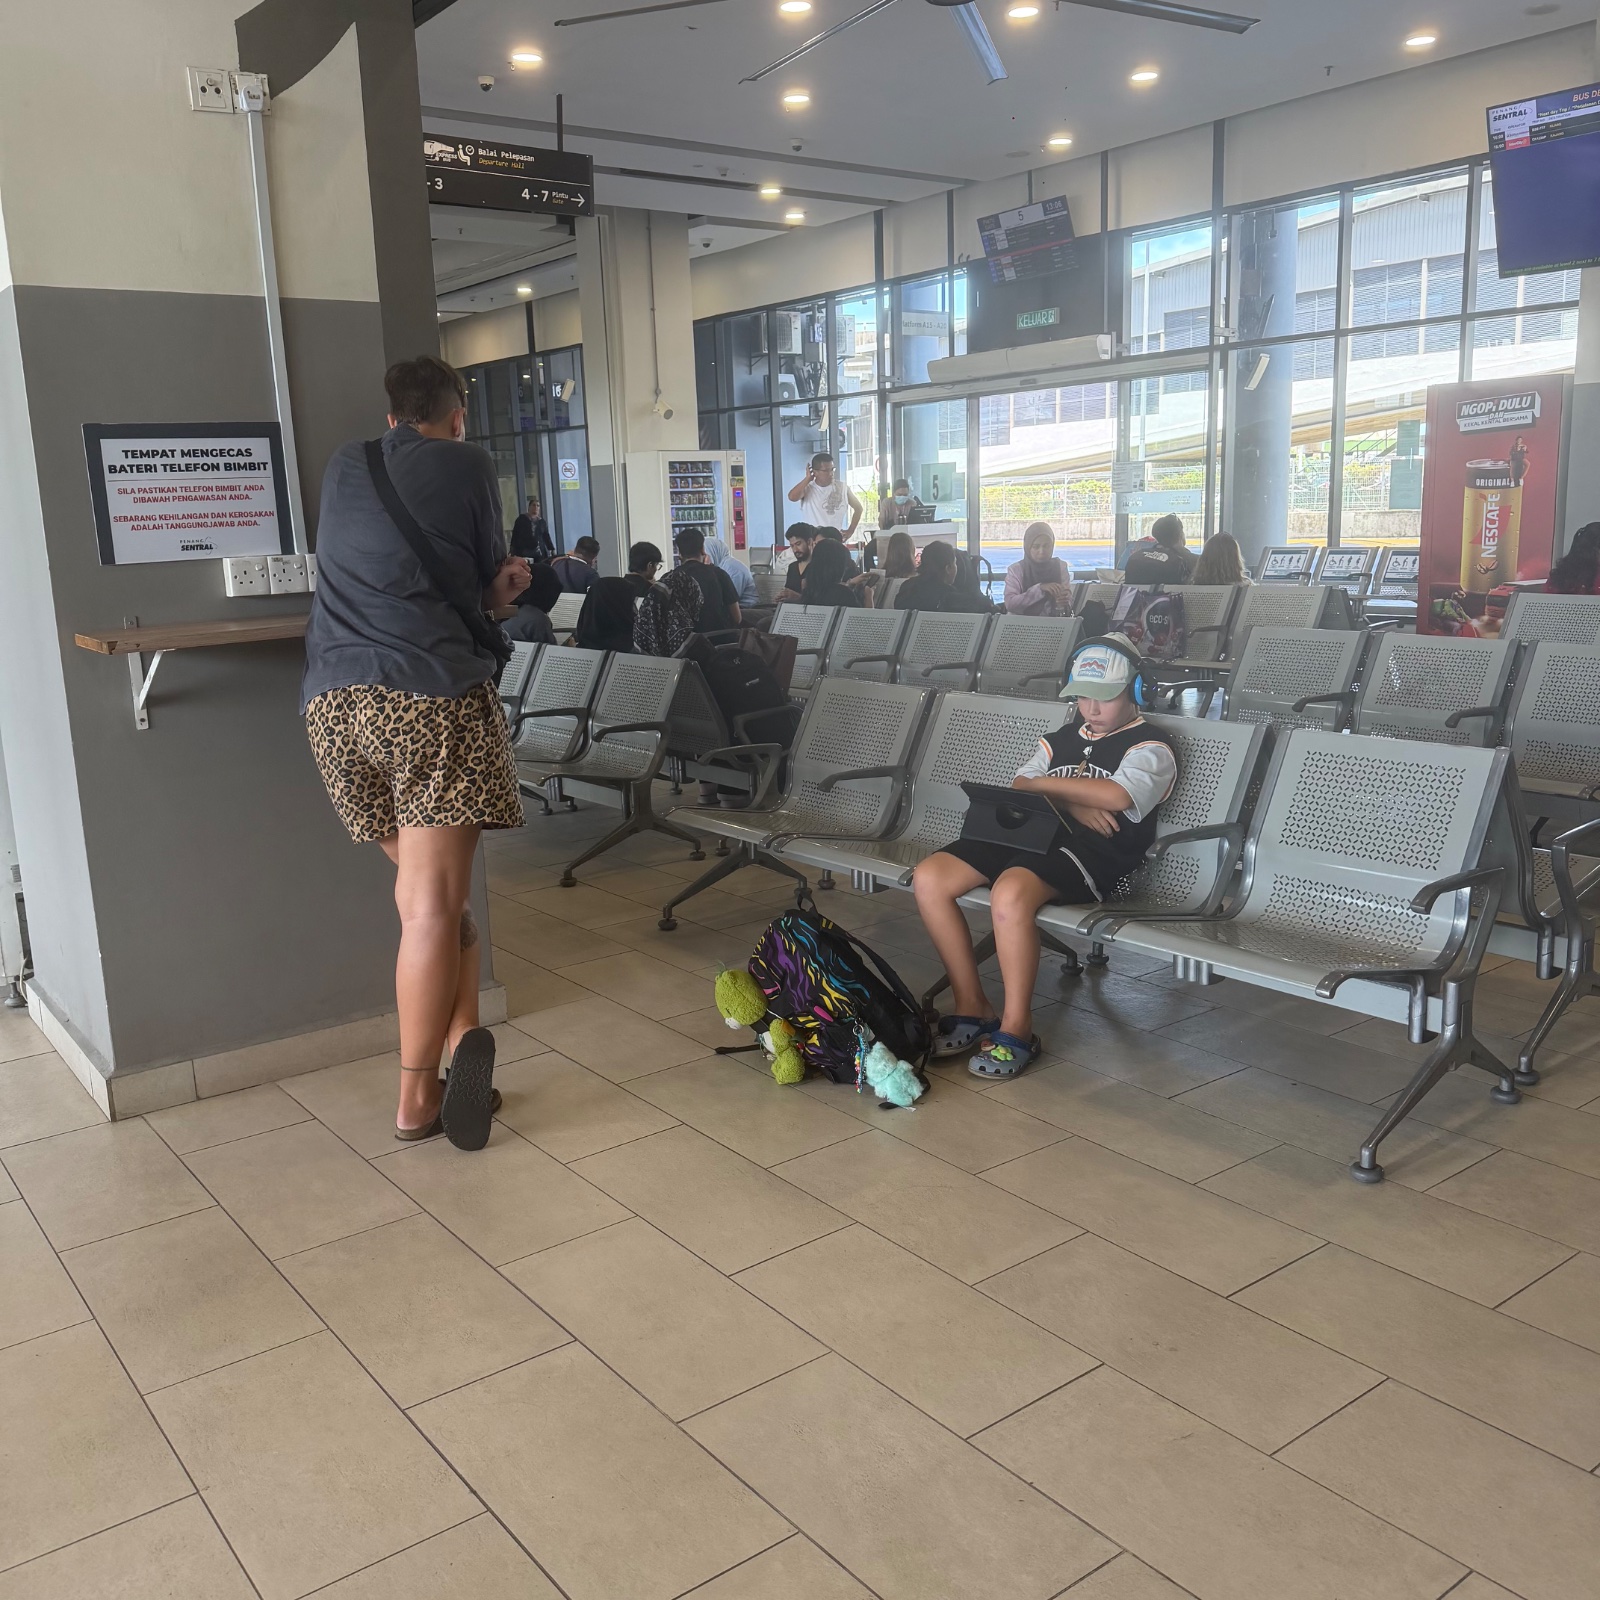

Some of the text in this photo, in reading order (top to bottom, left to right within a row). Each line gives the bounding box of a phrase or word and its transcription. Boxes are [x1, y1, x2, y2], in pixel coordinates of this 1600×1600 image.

[1573, 91, 1590, 102] BUS
[1492, 106, 1518, 114] PENANG
[1493, 109, 1528, 122] SENTRAL
[478, 148, 535, 162] Balai Pelepasan
[478, 158, 508, 168] Departure
[434, 178, 444, 190] 3
[521, 188, 530, 200] 4
[541, 190, 549, 202] 7
[1018, 211, 1024, 221] 5
[902, 320, 922, 328] latform
[1018, 312, 1047, 327] KELUAR
[1499, 396, 1532, 410] DULU
[1481, 418, 1502, 426] KENTAL
[1503, 415, 1528, 423] BERSAMA
[122, 448, 253, 459] TEMPAT MENGECAS
[108, 462, 268, 474] BATERI TELEFON BIMBIT
[932, 474, 939, 501] 5
[1476, 478, 1510, 486] ORIGINAL
[117, 487, 136, 495] SILA
[138, 486, 178, 494] PASTIKAN
[179, 485, 213, 493] TELEFON
[243, 484, 264, 492] ANDA
[133, 496, 170, 504] DIBAWAH
[172, 495, 227, 503] PENGAWASAN
[113, 514, 157, 523] SEBARANG
[159, 513, 209, 521] KEHILANGAN
[228, 511, 274, 519] KEROSAKAN
[131, 520, 260, 532] ADALAH TANGGUNGJAWAB ANDA.
[181, 544, 214, 552] SENTRAL
